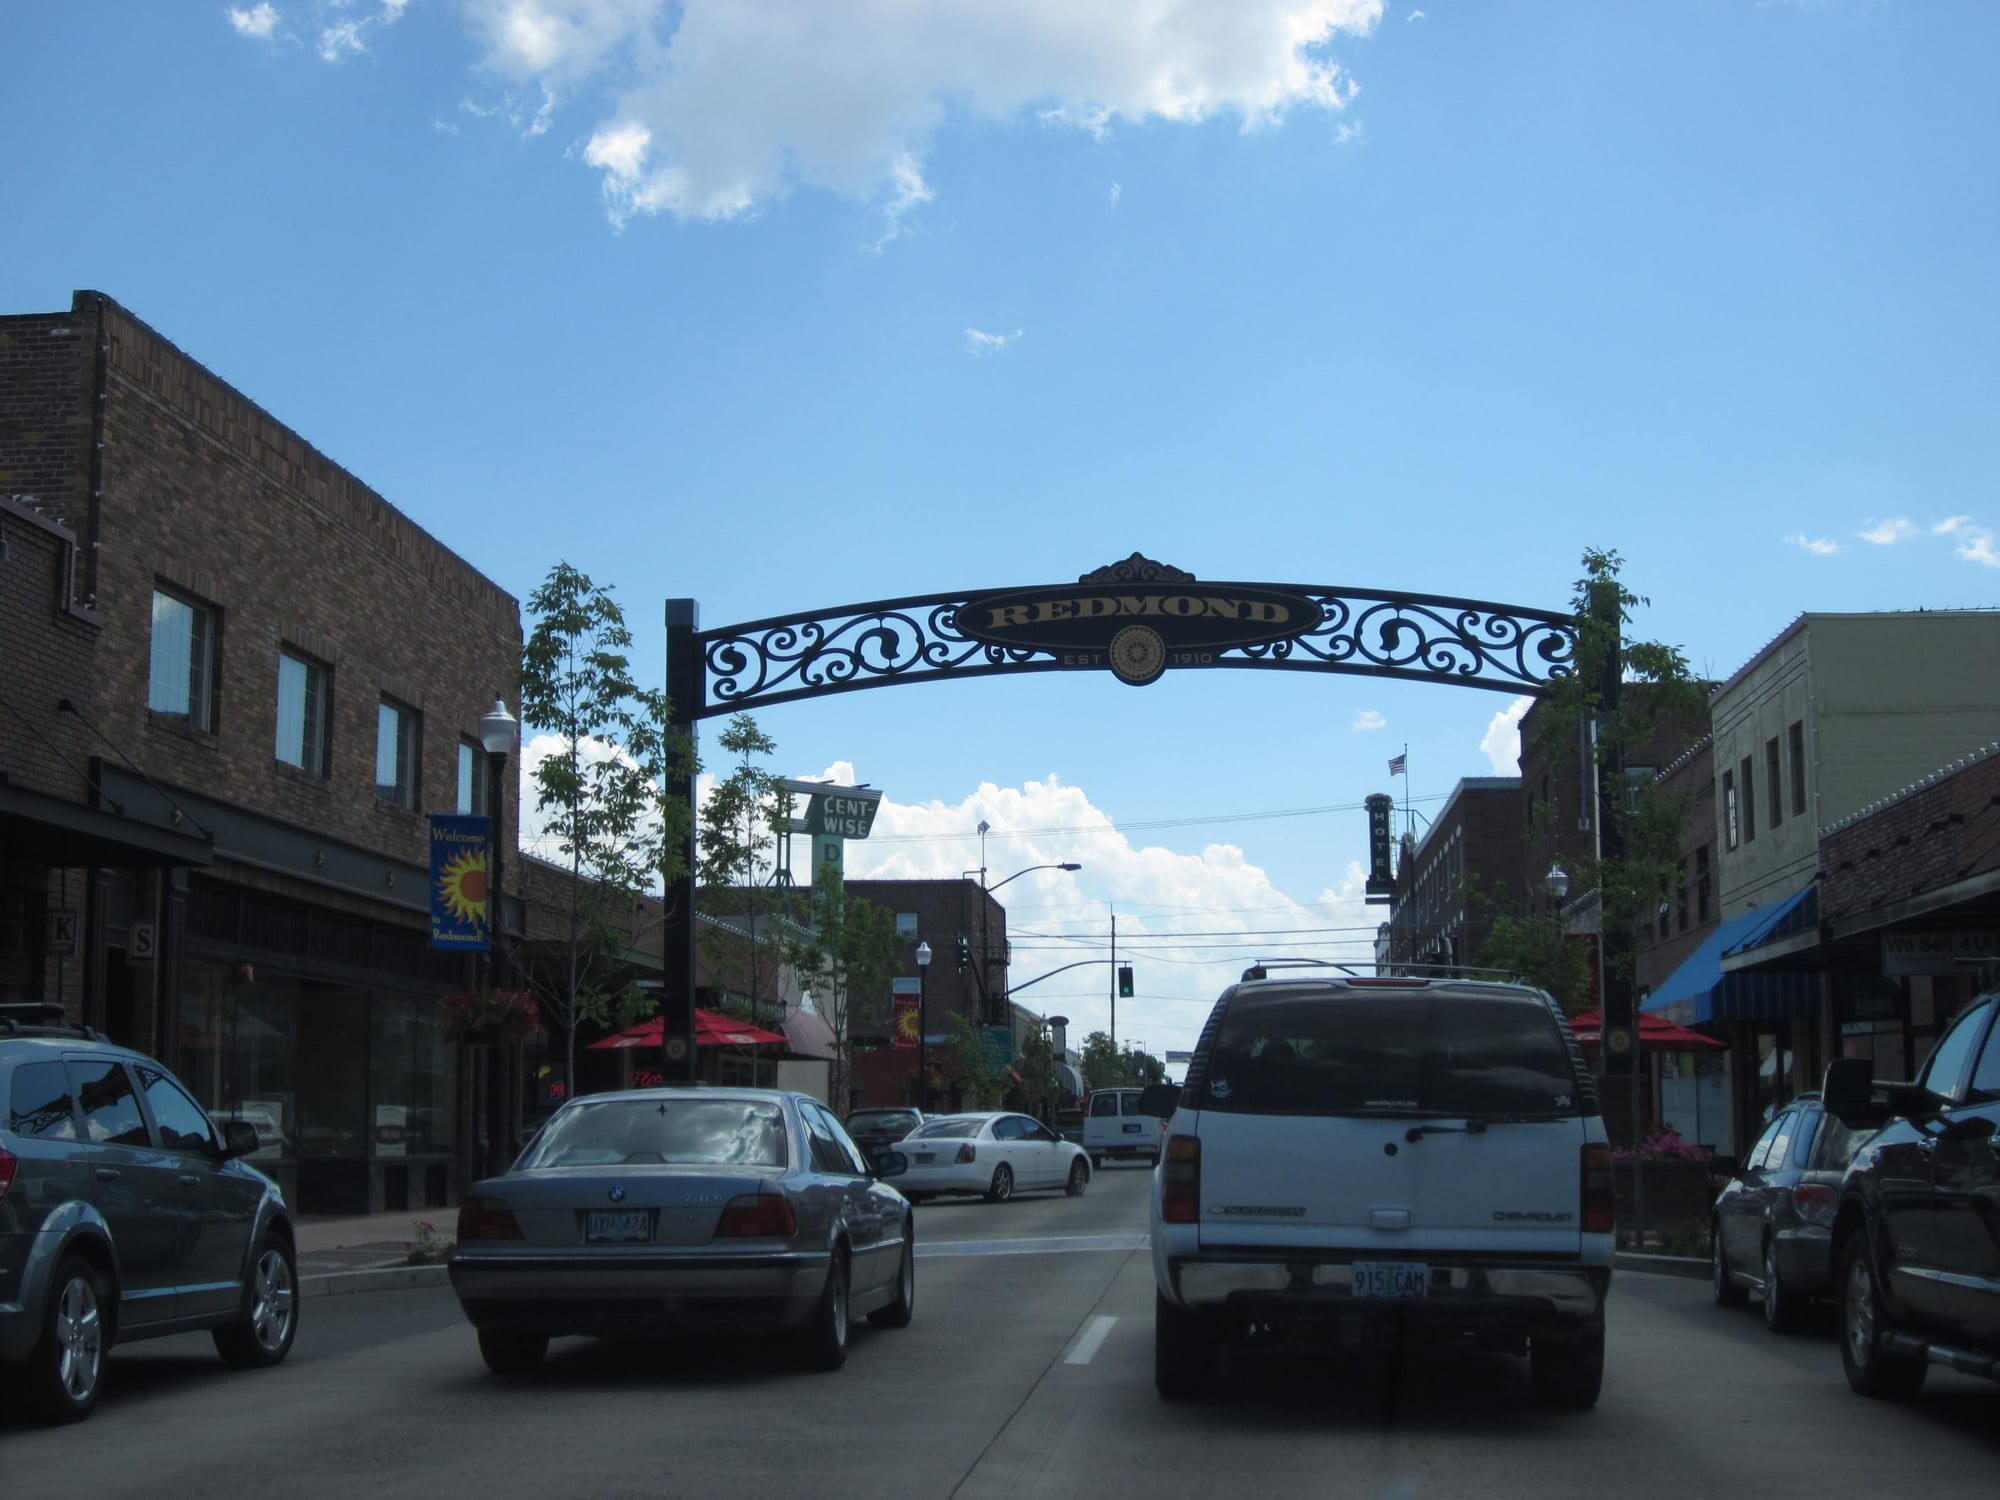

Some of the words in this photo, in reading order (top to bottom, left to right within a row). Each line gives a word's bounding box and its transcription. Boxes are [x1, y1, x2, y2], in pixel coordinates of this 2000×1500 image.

[987, 595, 1290, 629] REDMOND
[1064, 654, 1104, 665] EST
[1174, 652, 1212, 664] 1910
[432, 828, 485, 843] Welcome
[823, 816, 868, 836] WISE
[1374, 812, 1386, 881] HOTEL
[55, 917, 71, 940] K
[432, 915, 441, 925] to
[137, 929, 150, 952] S
[432, 928, 484, 942] Redmond!
[1355, 1271, 1386, 1292] 915
[1394, 1271, 1425, 1292] CAM
